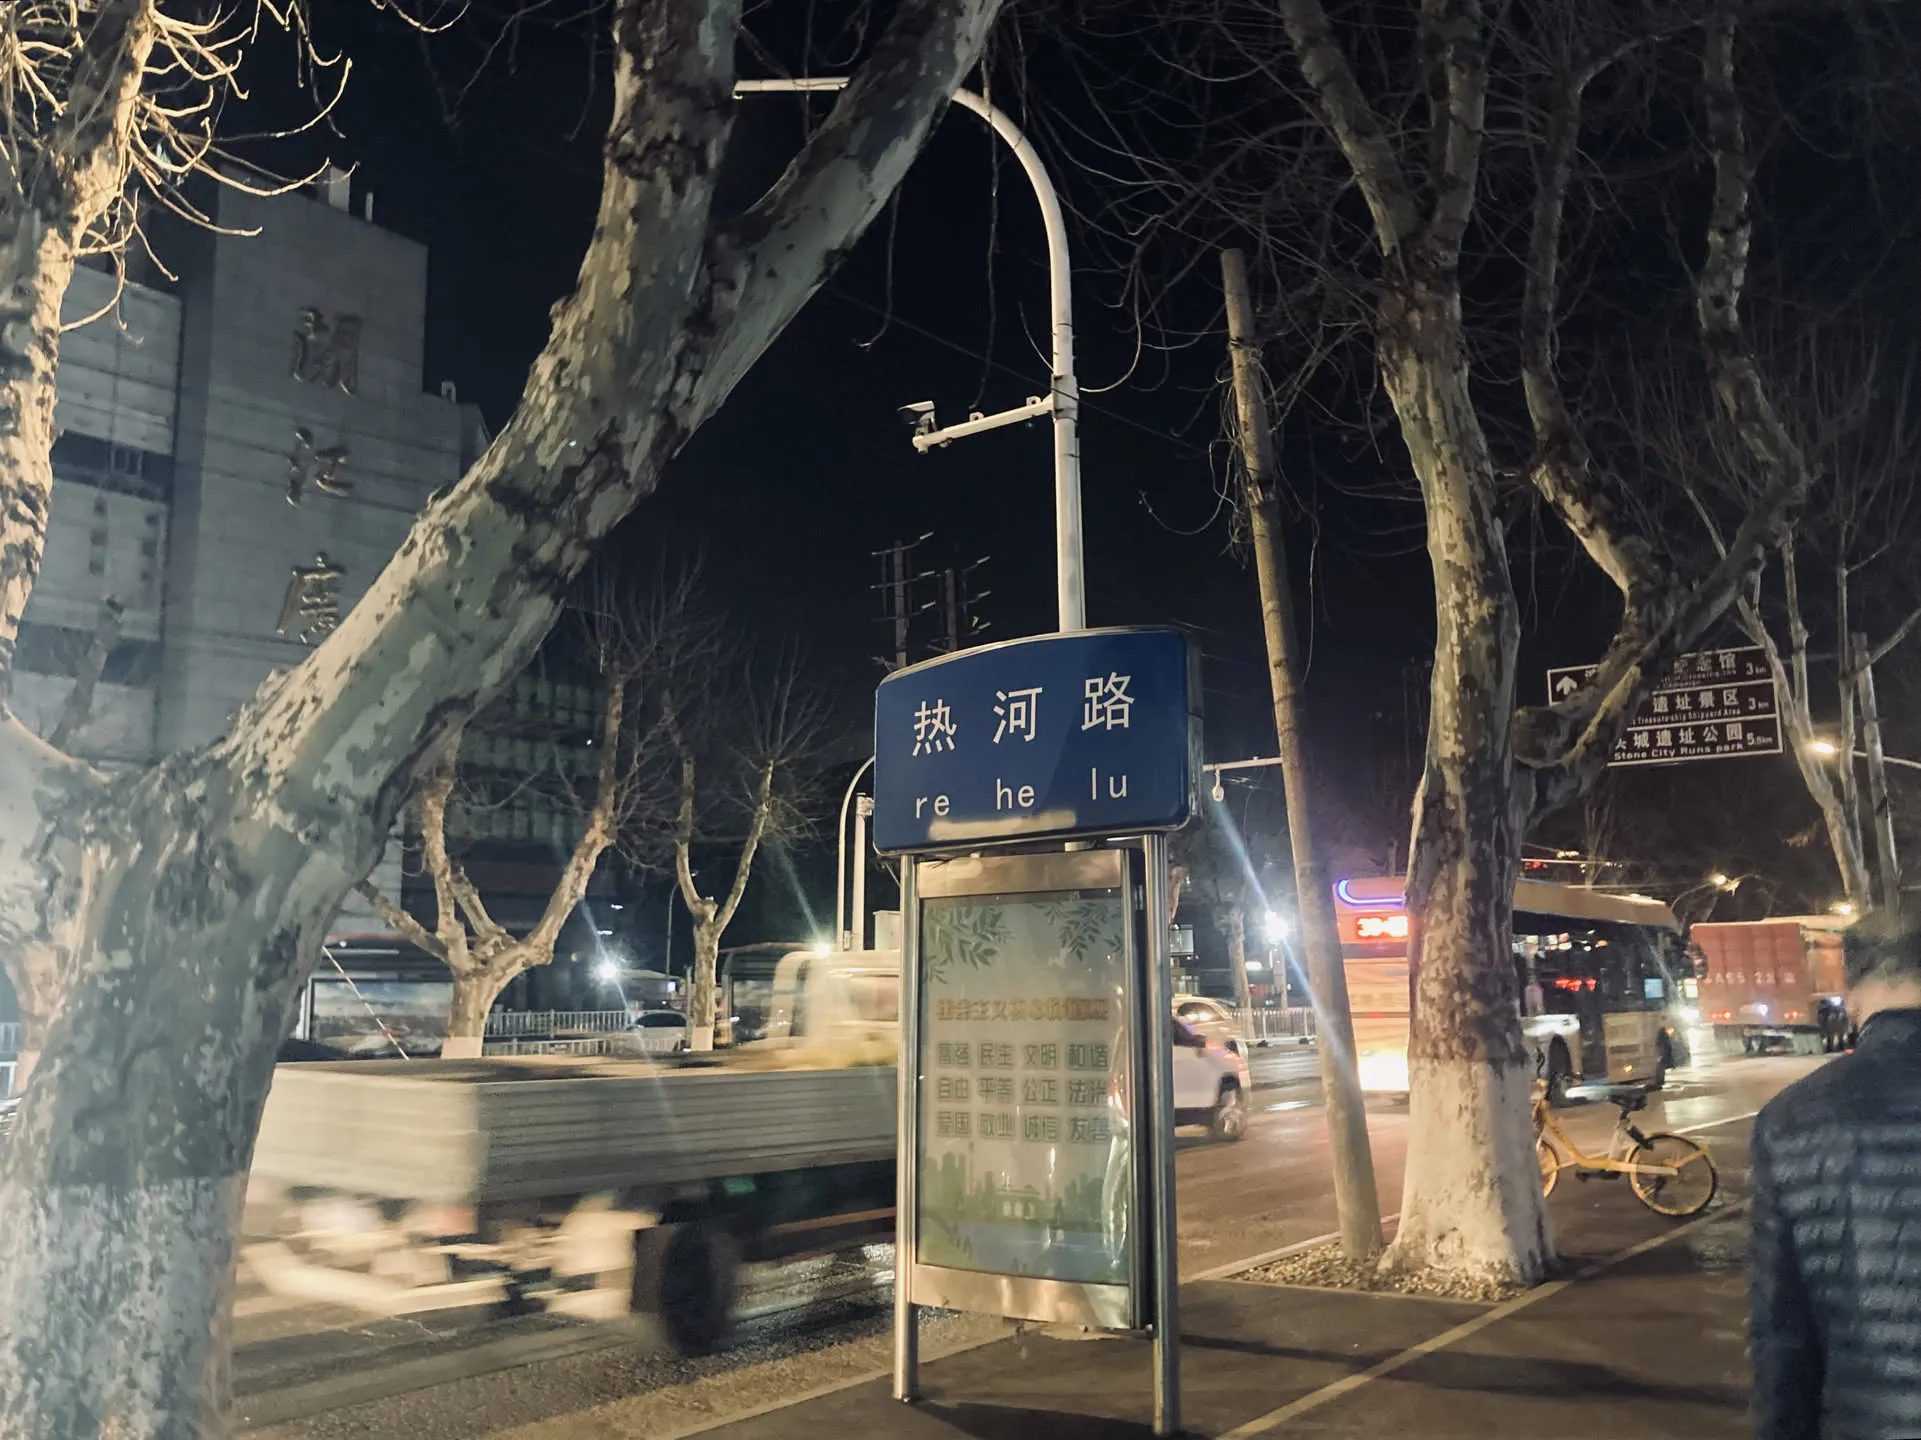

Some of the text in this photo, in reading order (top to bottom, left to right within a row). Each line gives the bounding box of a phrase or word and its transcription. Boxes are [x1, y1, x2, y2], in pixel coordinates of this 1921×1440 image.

[912, 671, 1135, 757] 热河路
[1614, 751, 1647, 761] Stone
[1652, 748, 1675, 758] City
[914, 767, 1128, 819] re he lu
[936, 998, 1109, 1021] 社会主义核心价值观
[938, 1042, 1109, 1068] 富强 民主 文明 和谐
[938, 1077, 1108, 1103] 自由 平等 公正 法治
[937, 1112, 1110, 1141] 爱国 敬业 诚信 友善
